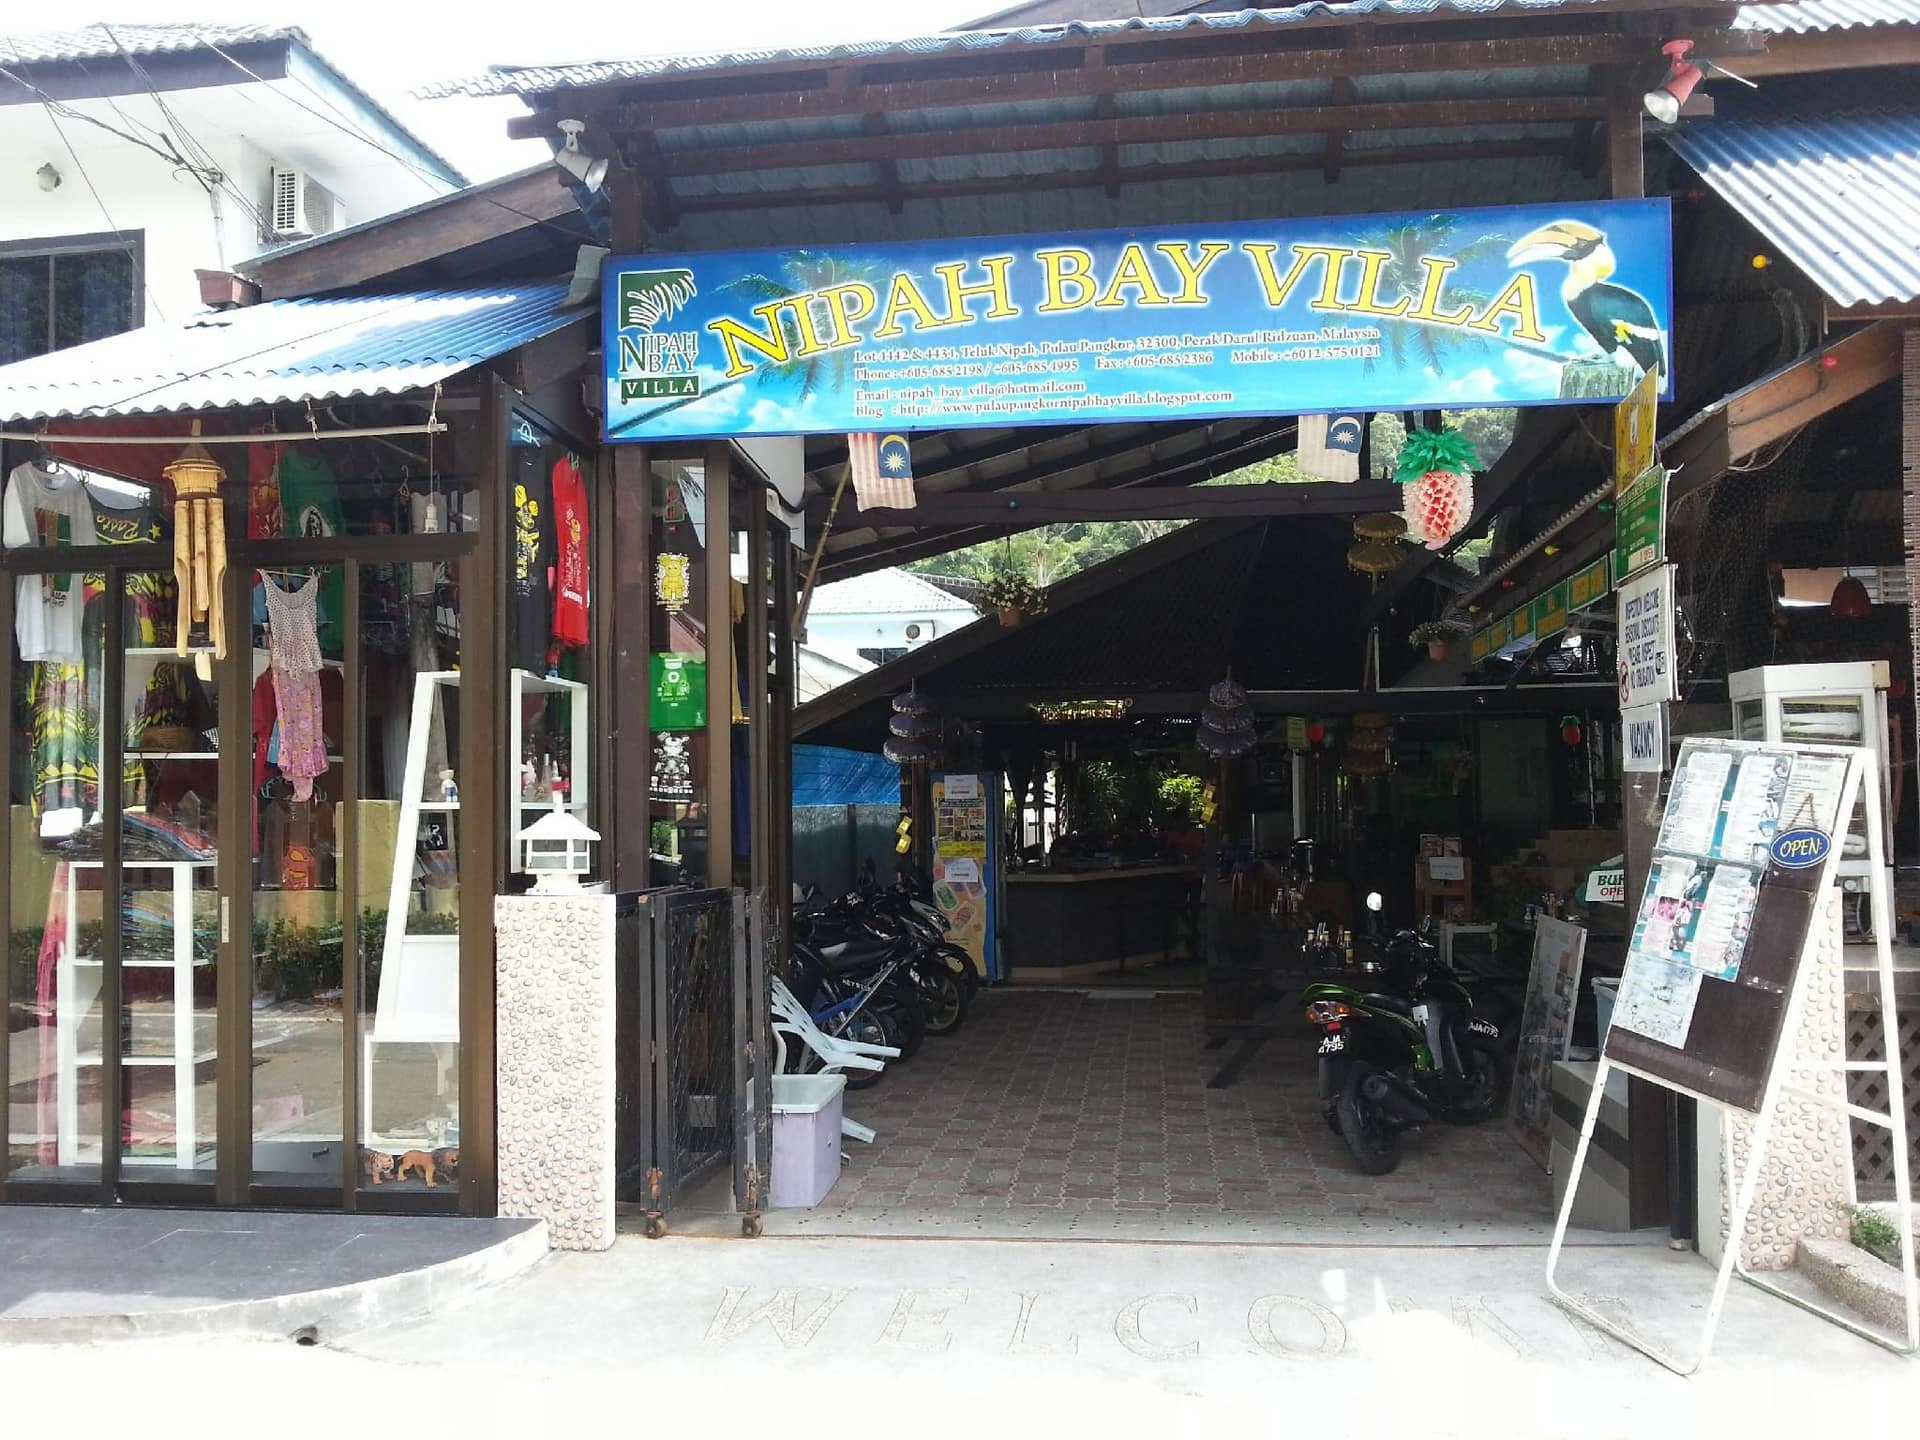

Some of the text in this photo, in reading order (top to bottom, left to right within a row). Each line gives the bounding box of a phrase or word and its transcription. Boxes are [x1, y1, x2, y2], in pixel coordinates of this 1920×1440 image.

[708, 244, 1545, 378] NIPAH BAY VILLA
[619, 333, 697, 373] NIPAH
[856, 351, 876, 362] Lot
[912, 349, 922, 360] &
[963, 345, 995, 358] Teluk
[999, 343, 1038, 359] Nipah,
[1042, 342, 1077, 354] Pulau
[1080, 338, 1135, 356] Pangkor,
[1139, 335, 1180, 349] 32300,
[1184, 333, 1221, 346] Perak
[1223, 332, 1258, 344] Darul
[1263, 329, 1319, 343] Ridzuan,
[1322, 327, 1380, 341] Malaysia
[648, 352, 697, 373] BAY
[856, 368, 890, 380] Phone
[956, 363, 982, 376] 2198
[1097, 357, 1118, 369] Fax
[1184, 352, 1213, 364] 2386
[1232, 350, 1274, 363] Mobile
[626, 379, 695, 395] VILLA
[856, 389, 889, 401] Email
[900, 381, 1085, 401] nipah_bay_villa@hotmail.com
[856, 405, 883, 418] Blog
[1629, 720, 1655, 759] VACANCY
[1780, 837, 1820, 858] OPEN
